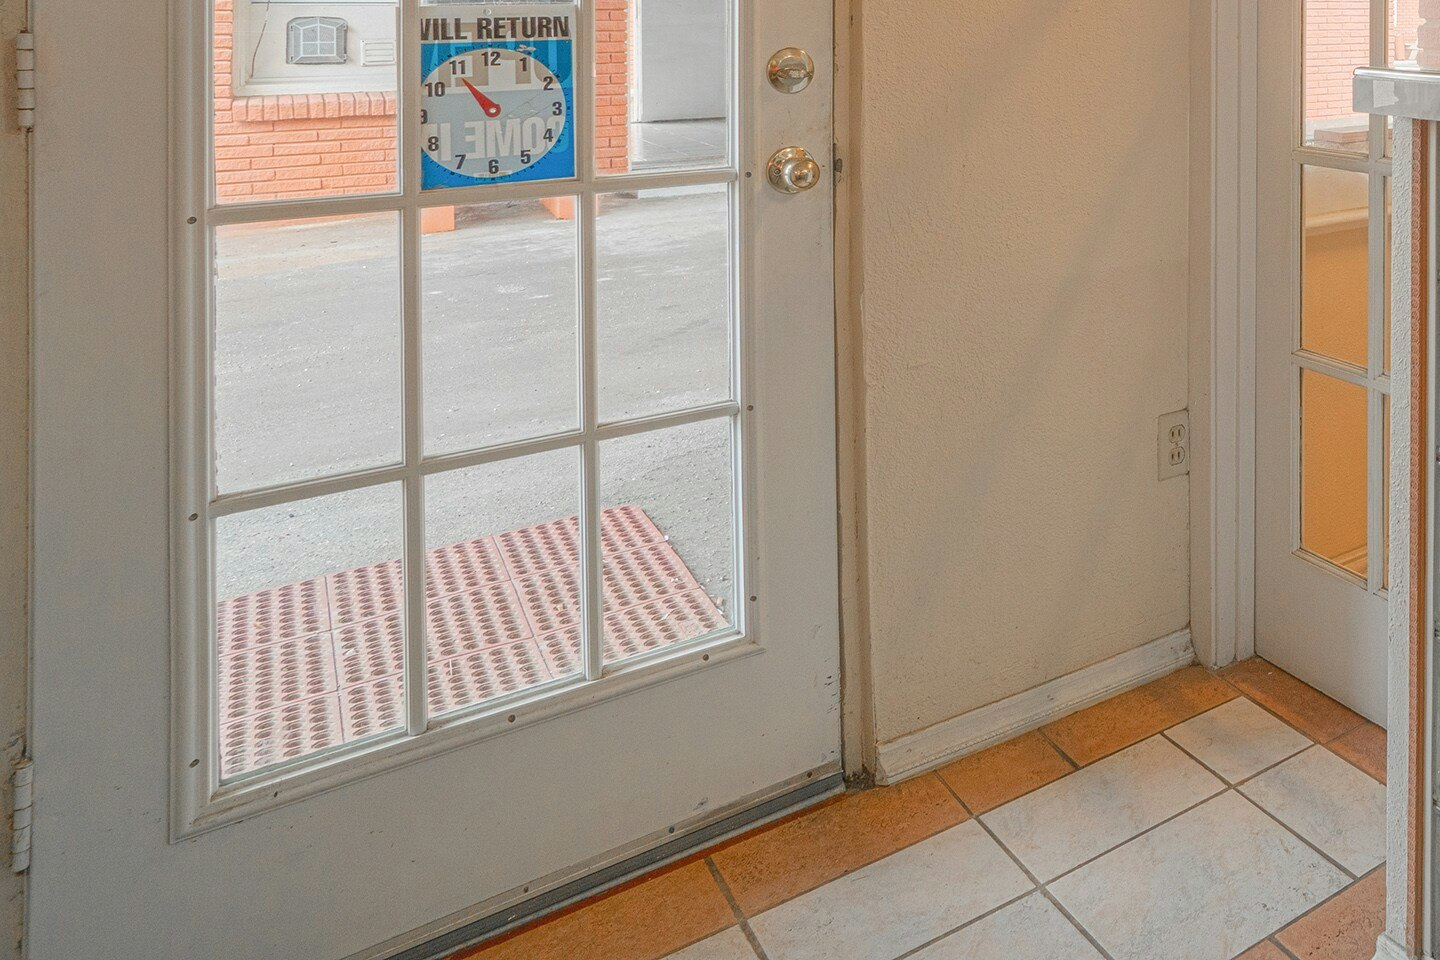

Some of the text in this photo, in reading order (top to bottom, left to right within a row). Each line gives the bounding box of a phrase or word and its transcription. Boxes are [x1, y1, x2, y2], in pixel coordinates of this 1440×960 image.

[477, 16, 569, 39] RETURN
[481, 51, 501, 66] 12
[519, 57, 528, 71] 1
[450, 60, 466, 75] 11
[425, 81, 446, 97] 10
[543, 76, 554, 91] 2
[552, 102, 562, 116] 3
[543, 128, 554, 142] 4
[428, 136, 440, 152] 8
[455, 154, 467, 170] 7
[521, 149, 531, 164] 5
[488, 159, 499, 174] 6
